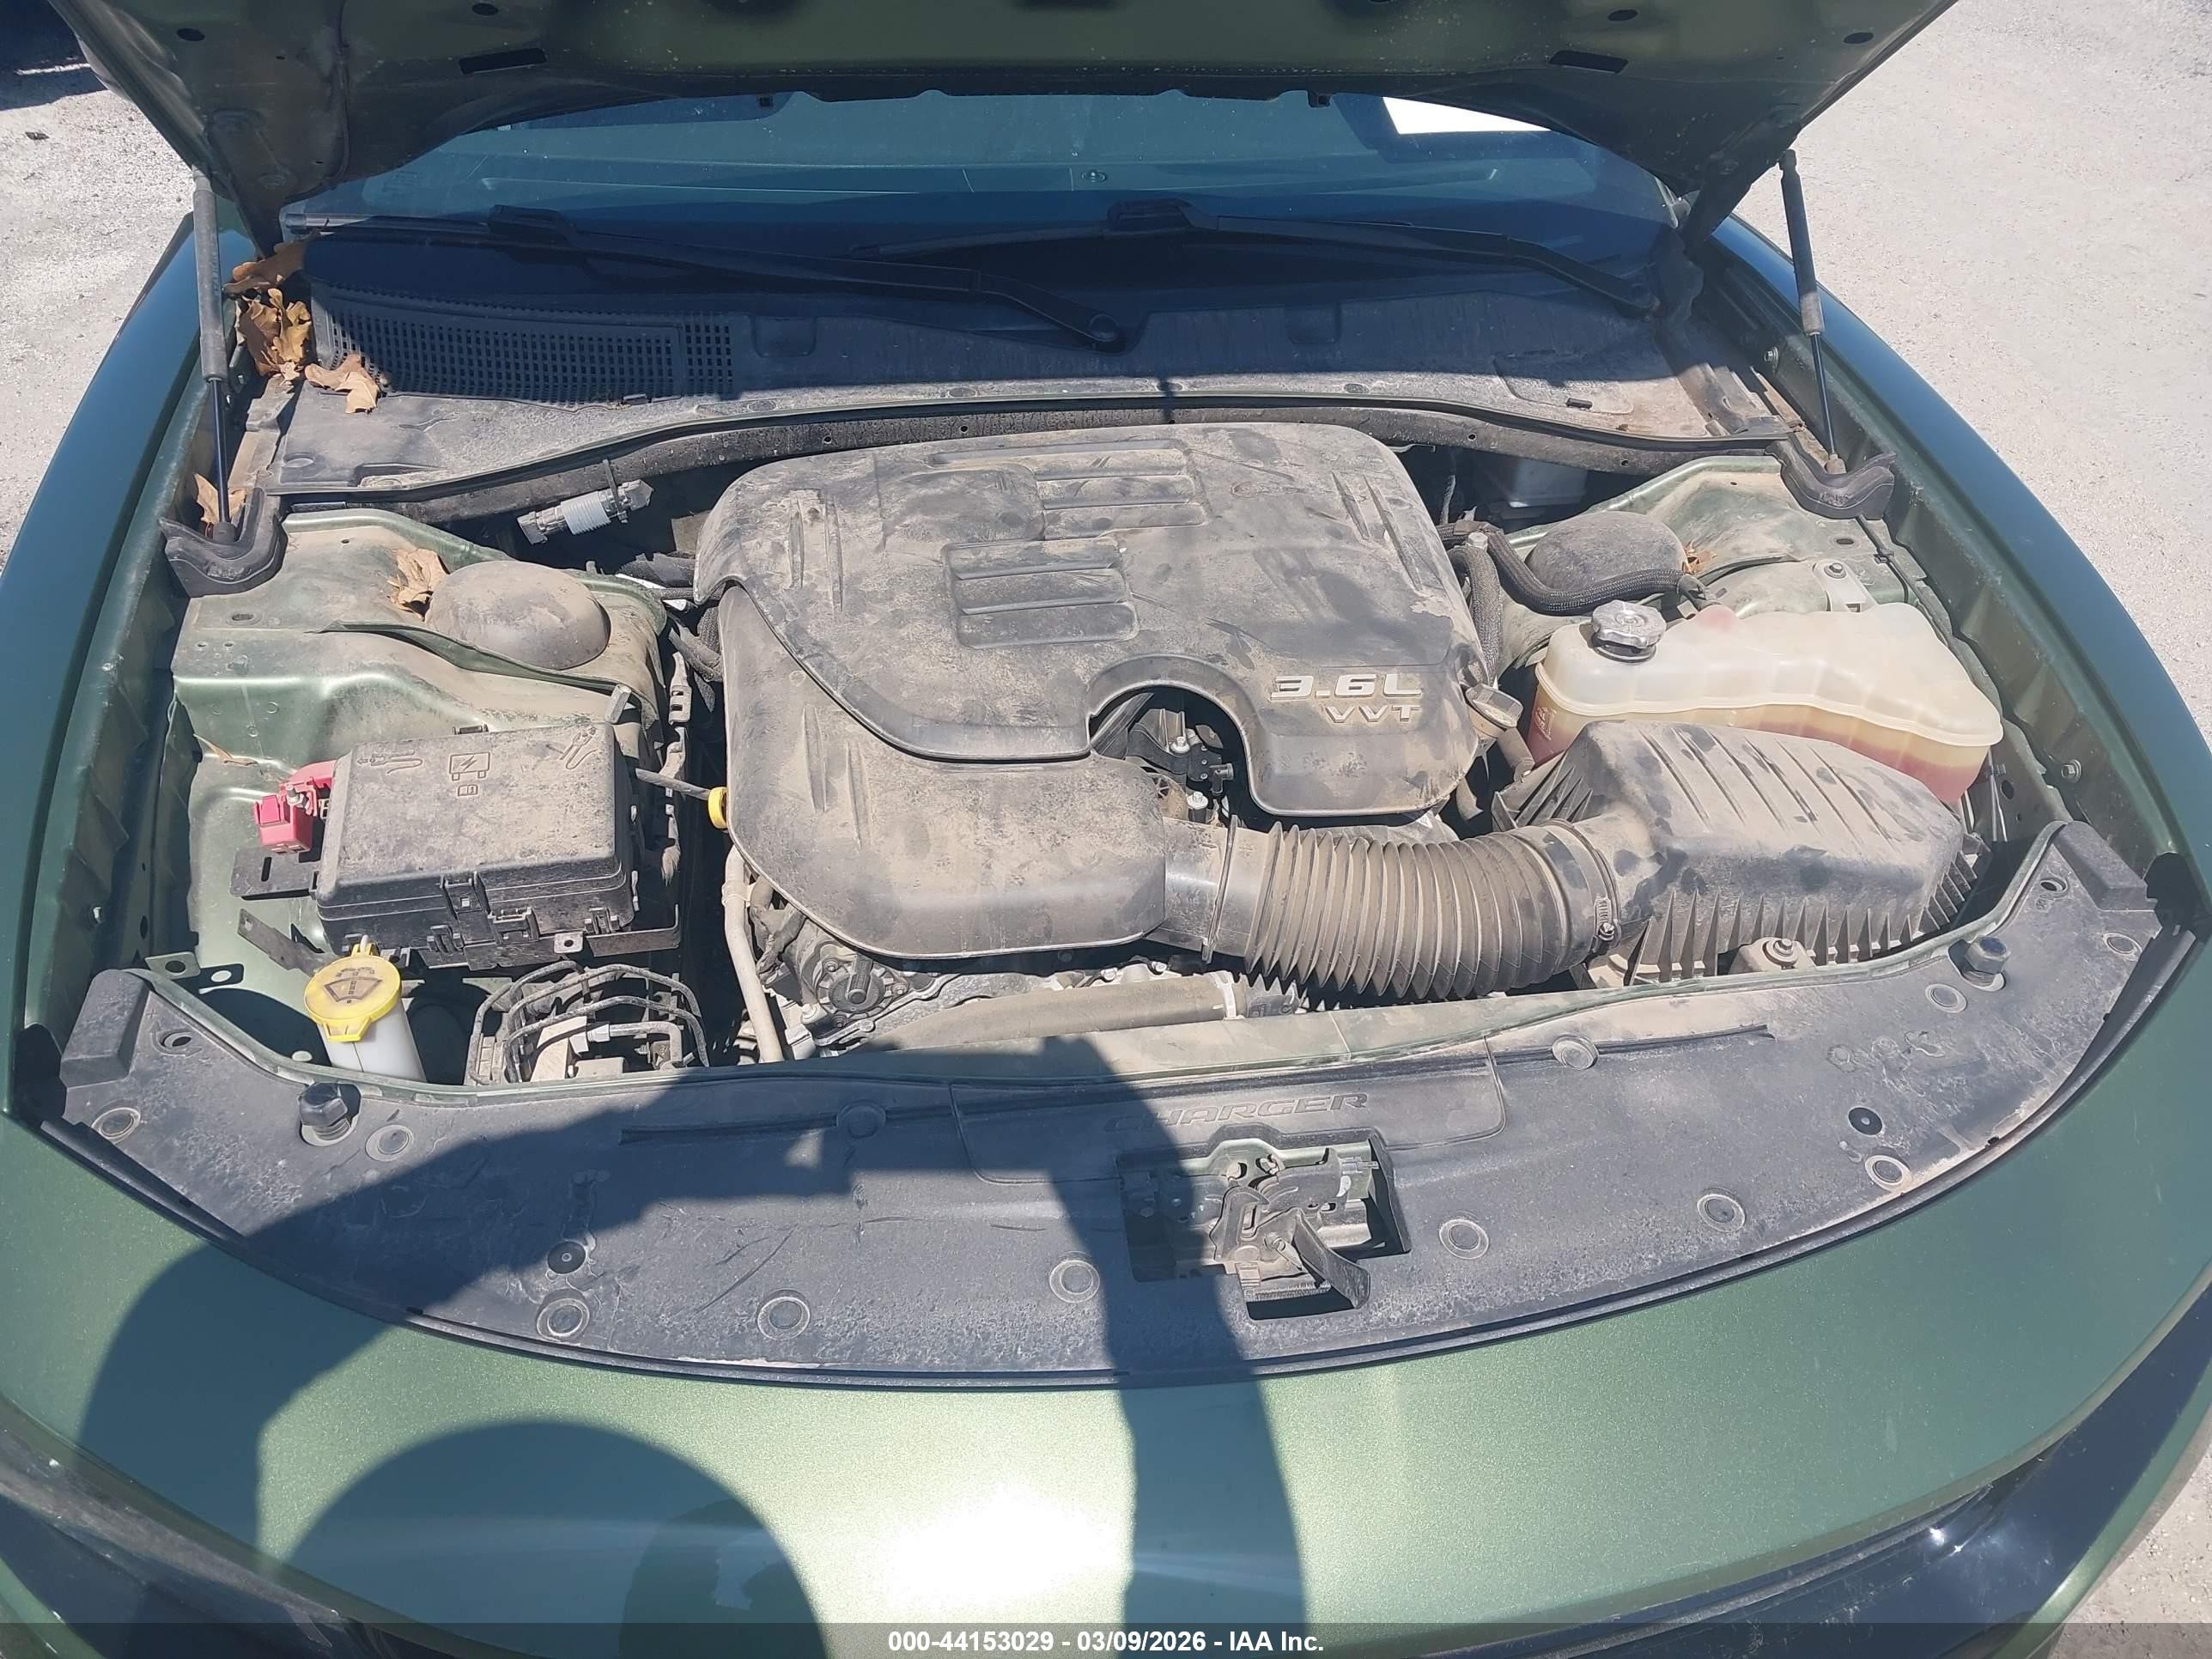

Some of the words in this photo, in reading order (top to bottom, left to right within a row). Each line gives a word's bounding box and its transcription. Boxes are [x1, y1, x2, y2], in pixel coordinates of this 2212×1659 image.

[1270, 673, 1423, 701] 3.6L
[1325, 704, 1421, 723] VVT
[1104, 1092, 1369, 1132] CHARGER
